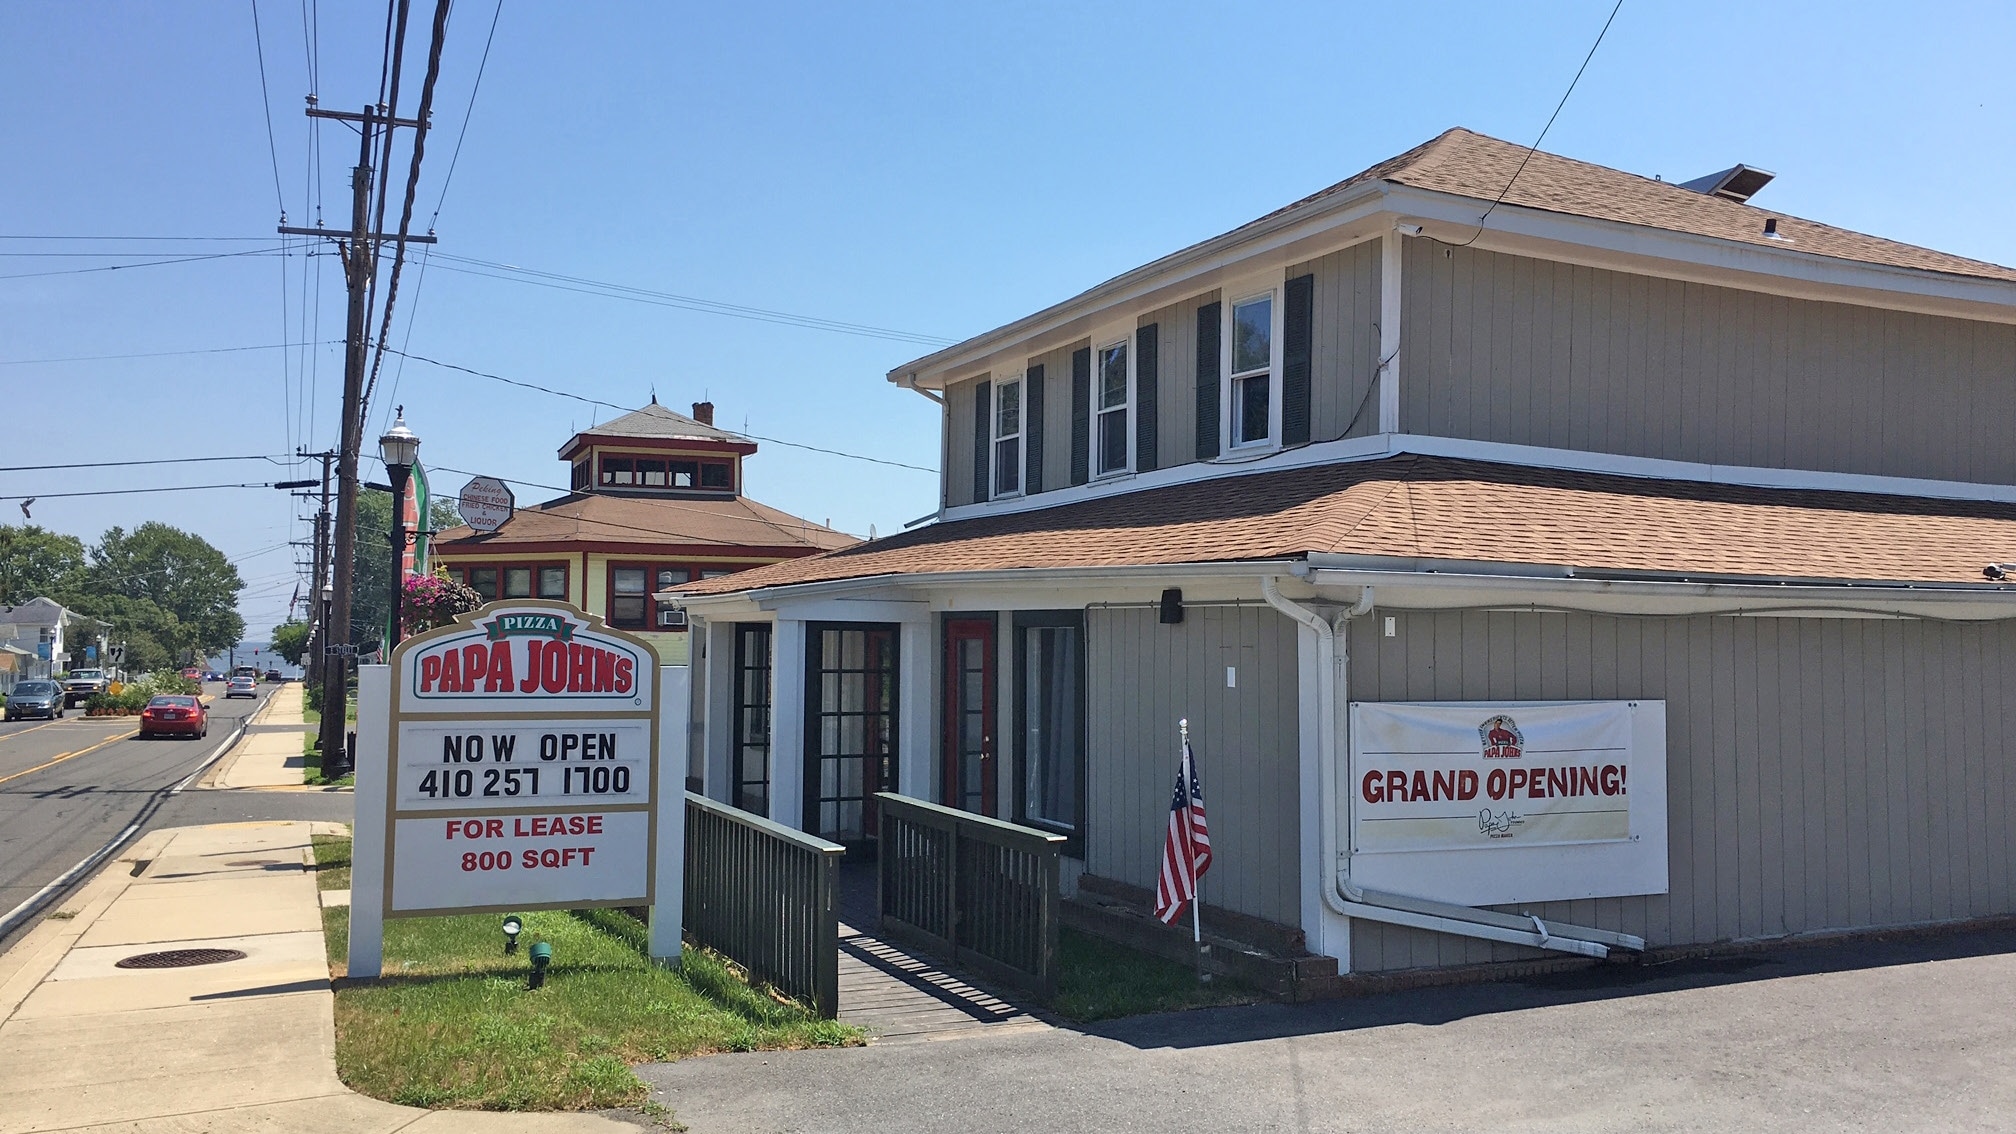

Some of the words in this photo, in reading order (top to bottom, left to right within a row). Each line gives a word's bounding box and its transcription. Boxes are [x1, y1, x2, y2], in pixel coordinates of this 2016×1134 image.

[462, 501, 480, 509] FRIED
[482, 503, 508, 512] CHICKEN
[463, 494, 489, 502] CHINESE
[491, 496, 508, 505] FOOD
[471, 517, 497, 526] LIQUOR
[504, 616, 558, 630] PIZZA
[421, 640, 514, 693] PAPA
[520, 640, 633, 694] JOHN'S
[443, 734, 516, 763] NOW
[540, 733, 616, 761] OPEN
[419, 769, 473, 797] 410
[483, 768, 539, 796] 257
[563, 766, 630, 794] 1700
[1362, 769, 1479, 804] GRAND
[1486, 764, 1627, 800] OPENING!
[446, 819, 504, 840] FOR
[514, 816, 603, 837] LEASE
[461, 850, 512, 871] 800
[522, 847, 595, 869] SQFT
